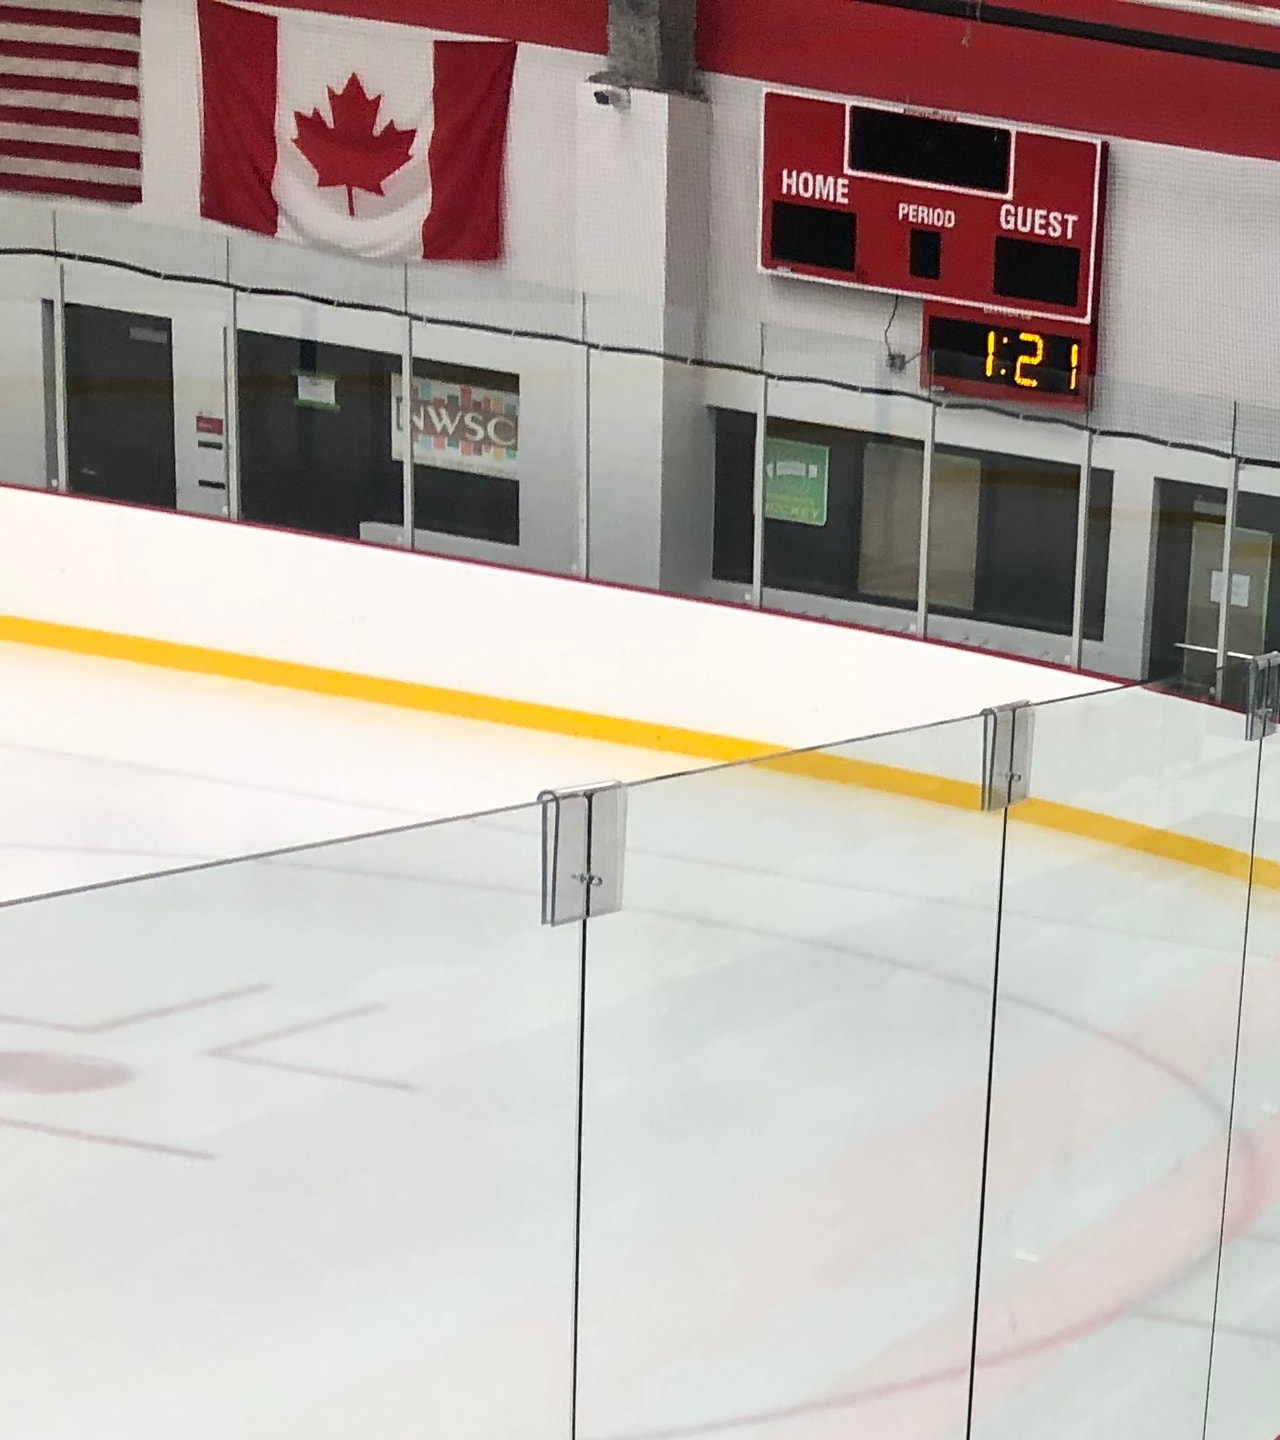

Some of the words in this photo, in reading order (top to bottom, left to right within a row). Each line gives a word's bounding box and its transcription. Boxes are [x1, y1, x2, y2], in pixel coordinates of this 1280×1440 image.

[782, 168, 849, 204] HOME
[898, 202, 956, 228] PERIOD
[1000, 203, 1079, 240] GUEST
[986, 331, 1078, 390] 1:21
